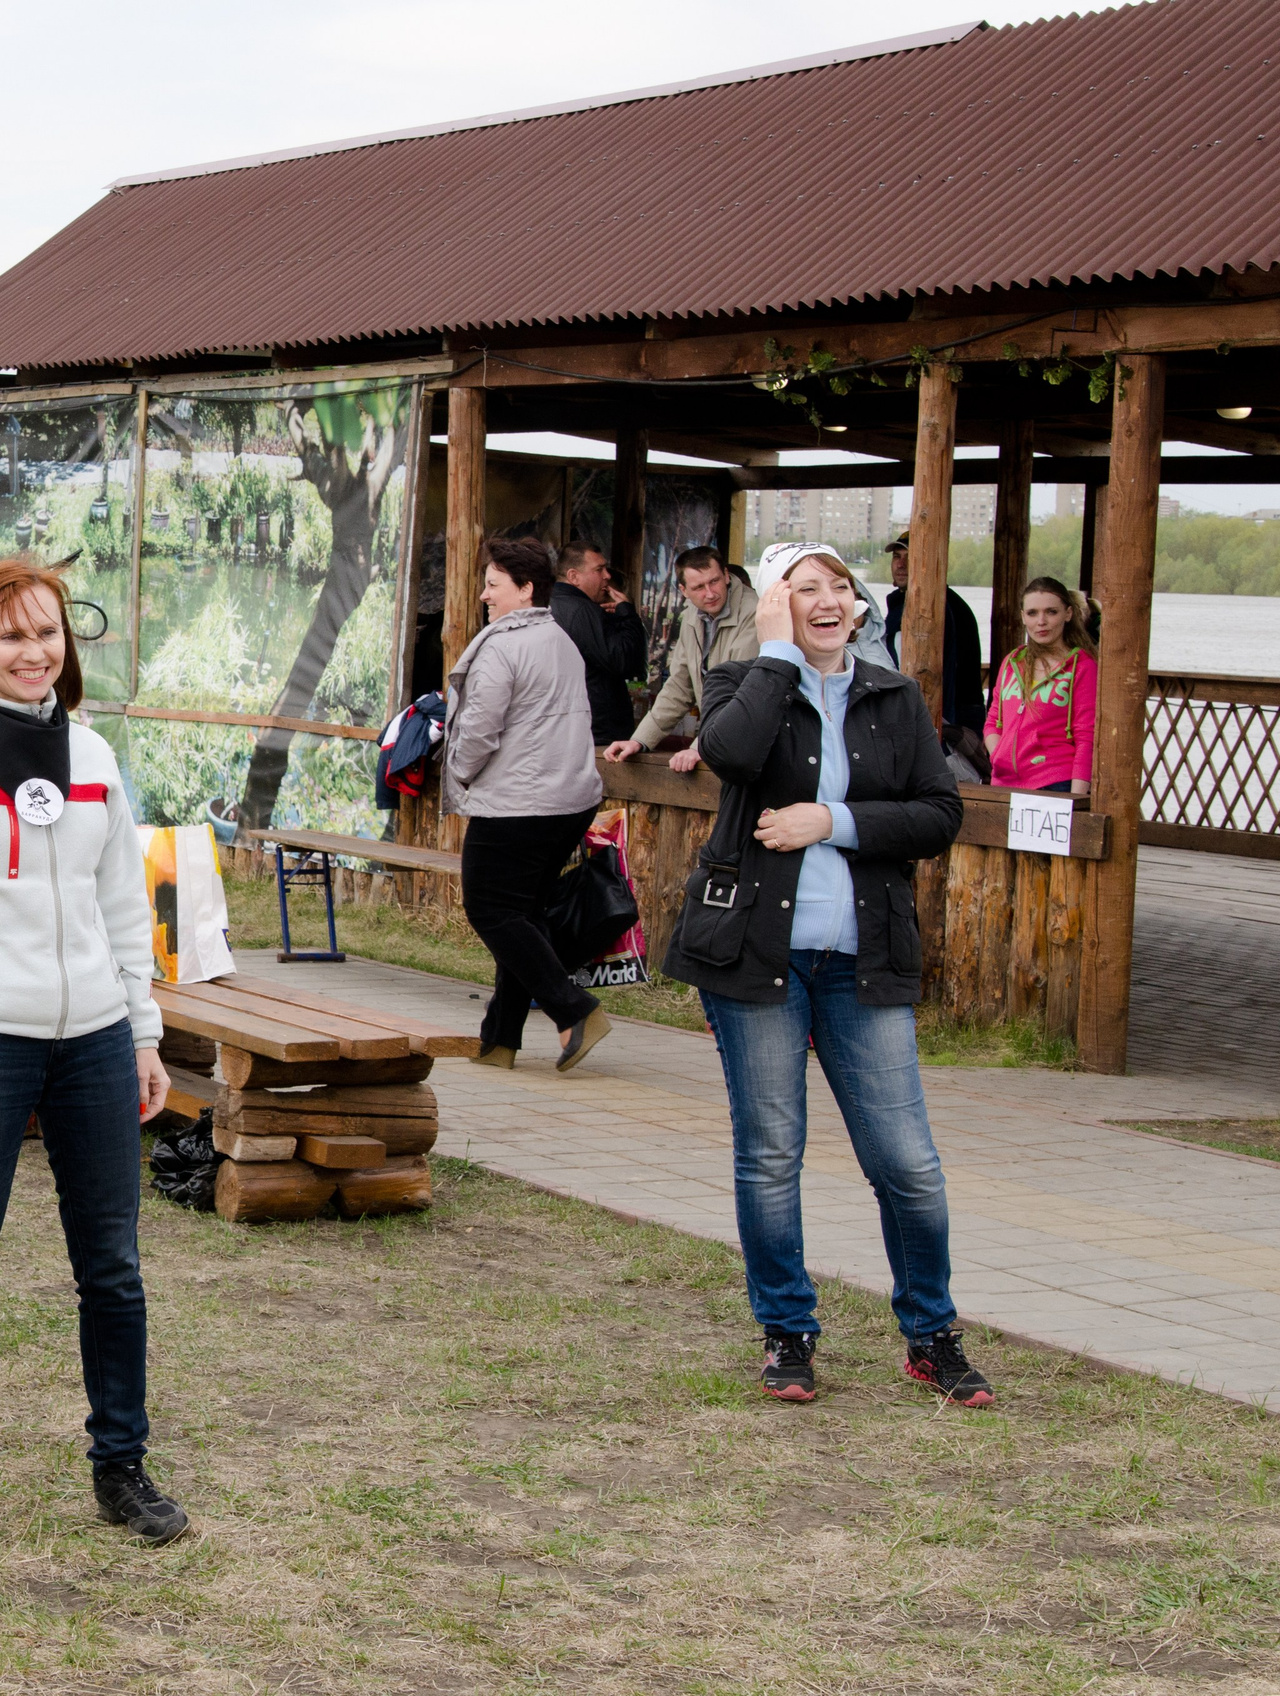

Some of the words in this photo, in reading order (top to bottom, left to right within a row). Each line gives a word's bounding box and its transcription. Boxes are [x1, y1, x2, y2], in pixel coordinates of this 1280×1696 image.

[1001, 669, 1073, 707] VANS
[21, 811, 54, 822] БАРРАКУДА
[1009, 807, 1070, 843] ШТАБ
[589, 963, 637, 986] Markt
